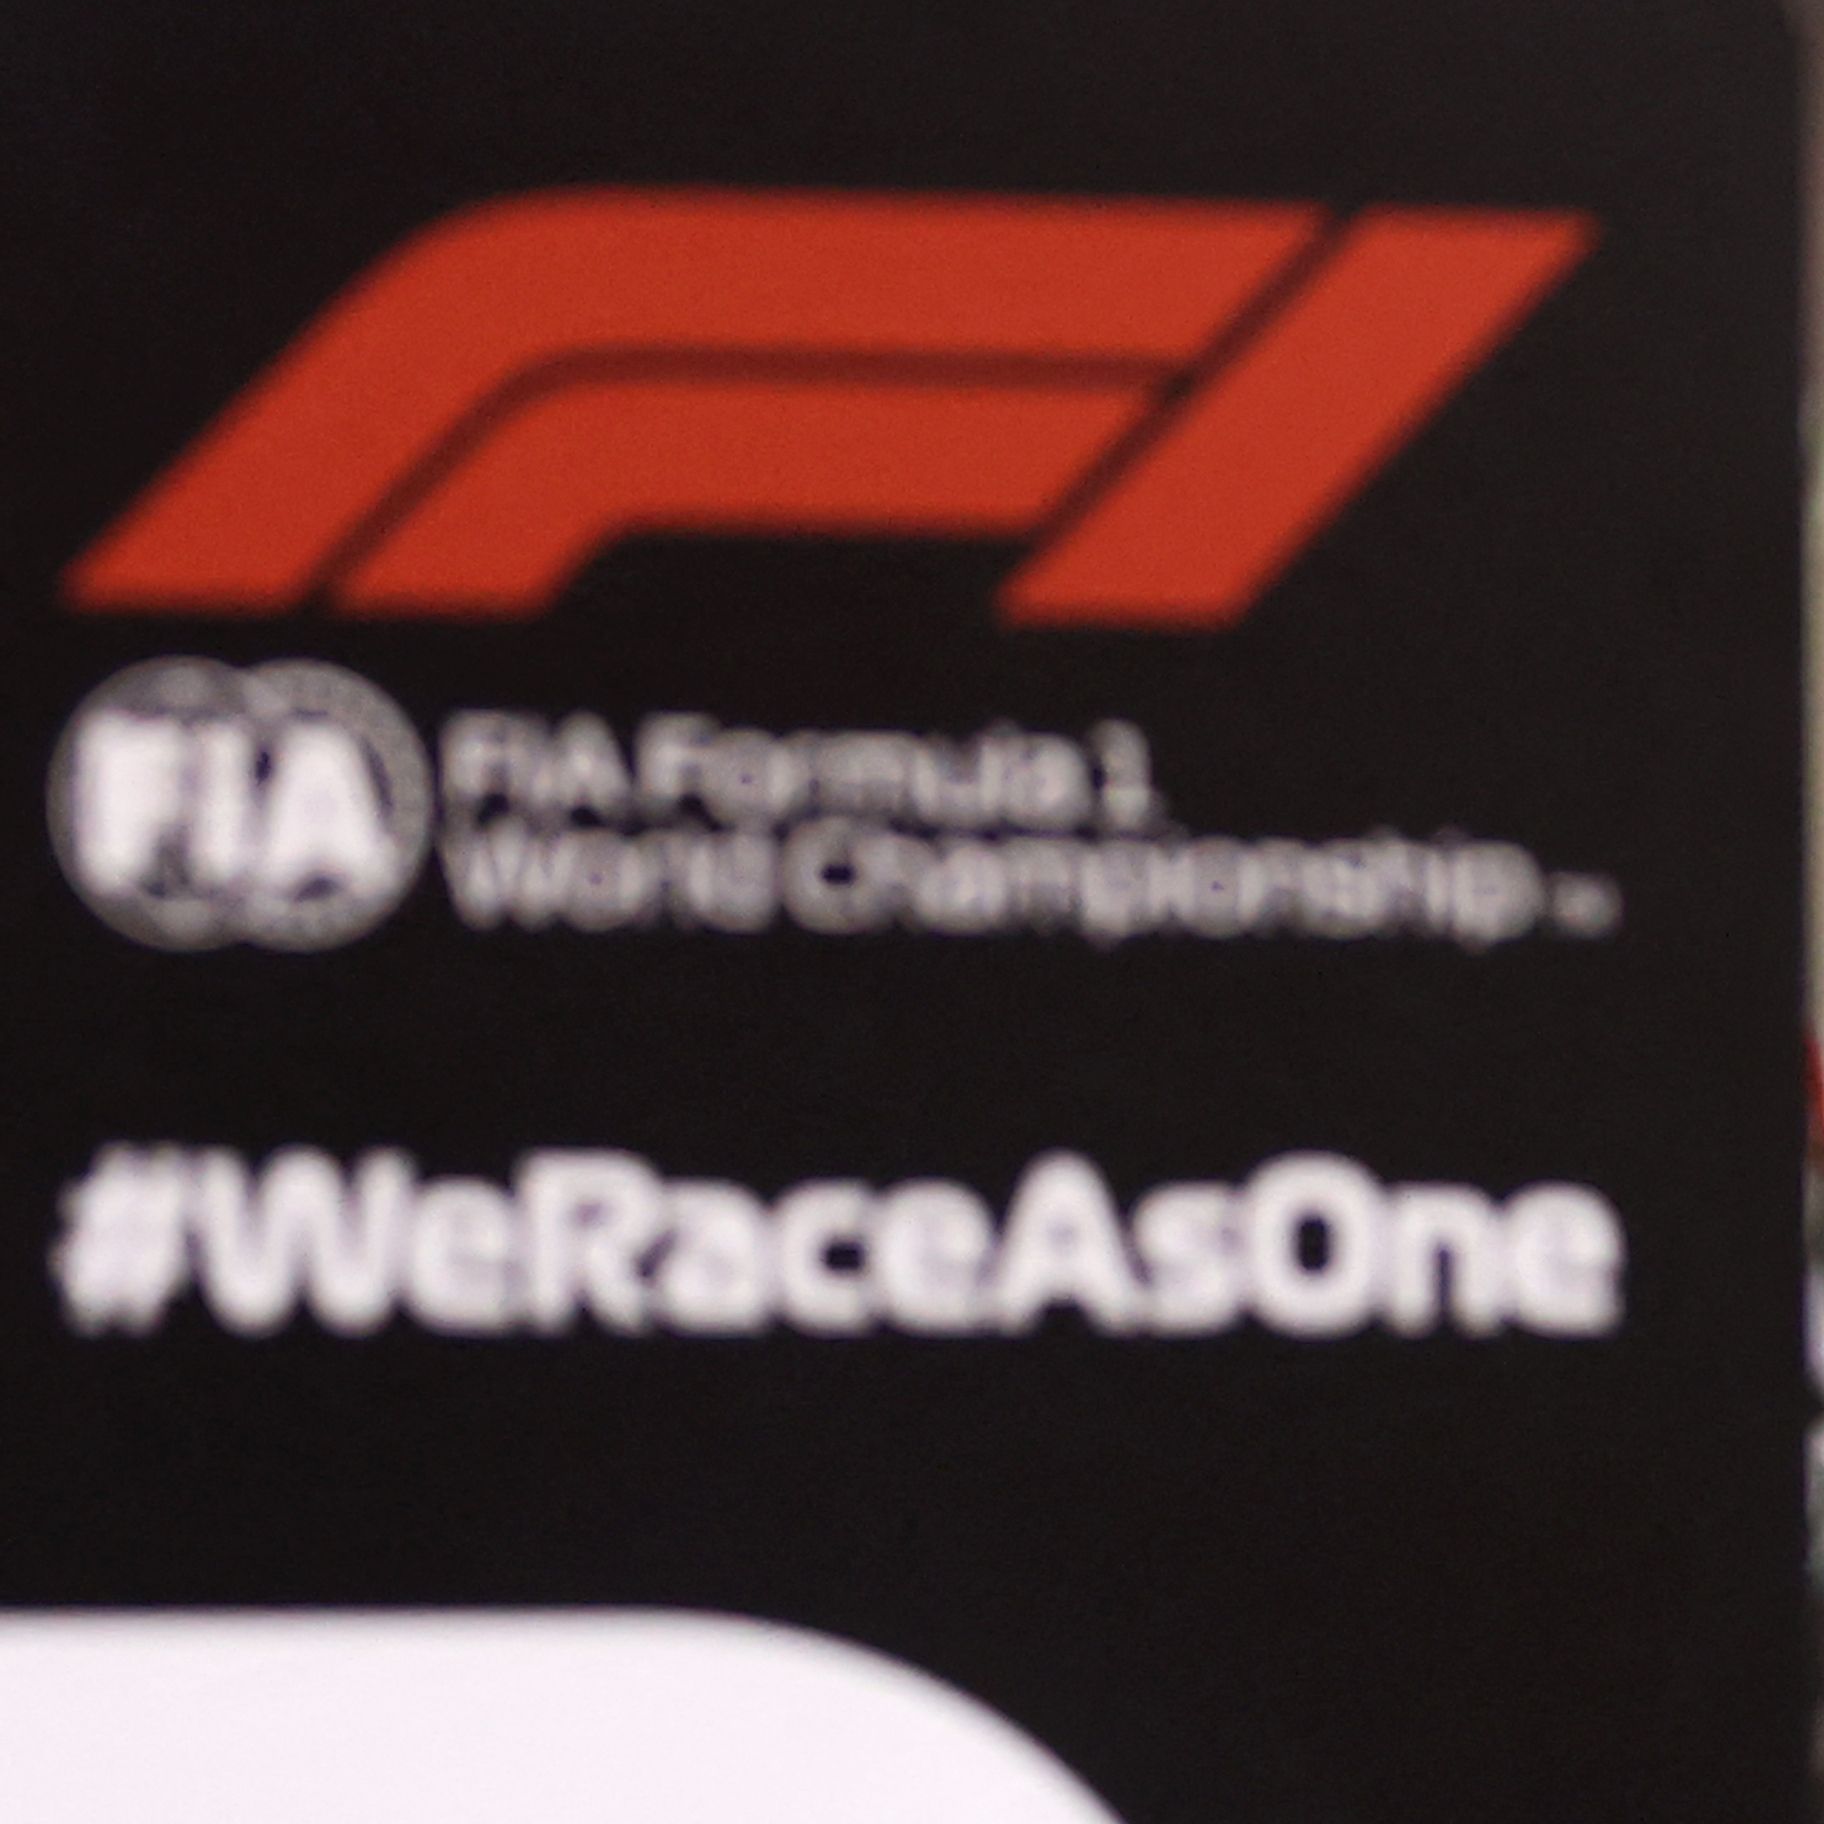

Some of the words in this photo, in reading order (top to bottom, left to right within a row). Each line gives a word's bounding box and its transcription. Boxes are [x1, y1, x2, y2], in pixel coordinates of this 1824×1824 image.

[636, 710, 1092, 828] Formula
[440, 824, 782, 931] World
[785, 816, 1548, 952] Championship
[55, 1144, 1626, 1338] #WeRaceAsOne
